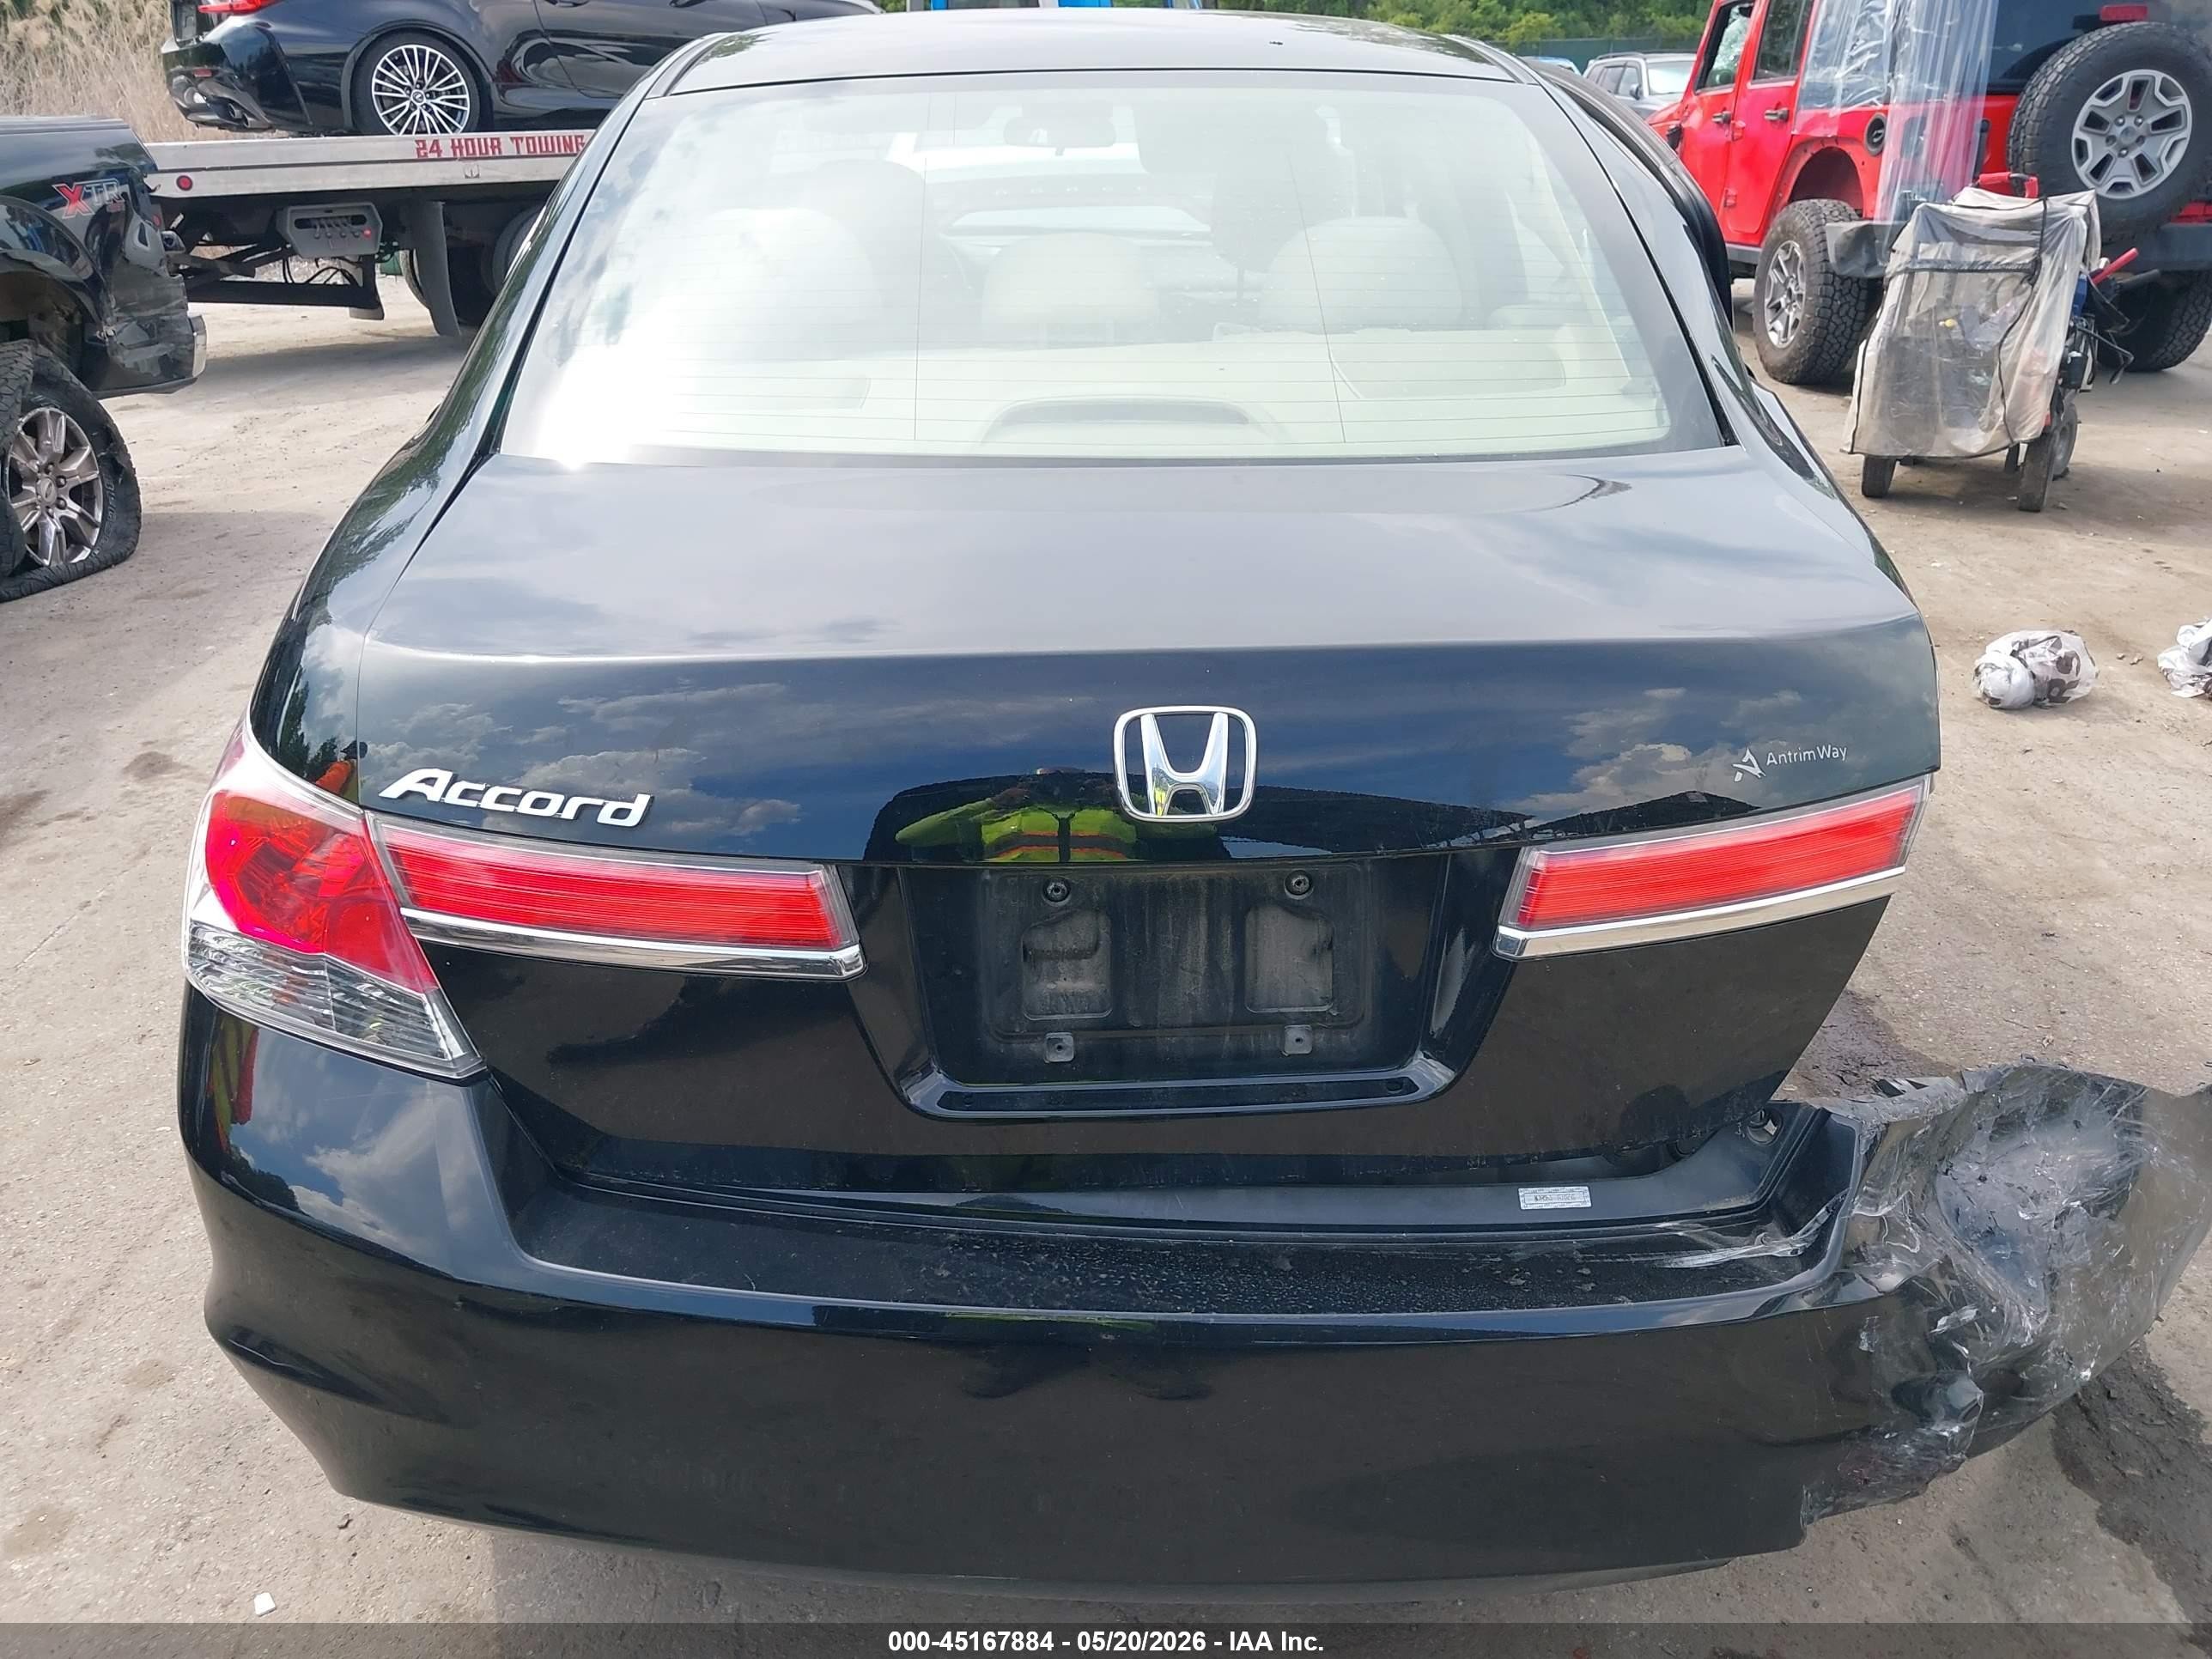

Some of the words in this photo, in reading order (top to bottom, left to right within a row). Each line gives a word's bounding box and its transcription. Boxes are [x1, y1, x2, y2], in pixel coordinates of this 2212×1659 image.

[415, 139, 443, 158] 24
[450, 137, 502, 156] HOUR
[378, 768, 654, 827] Accord
